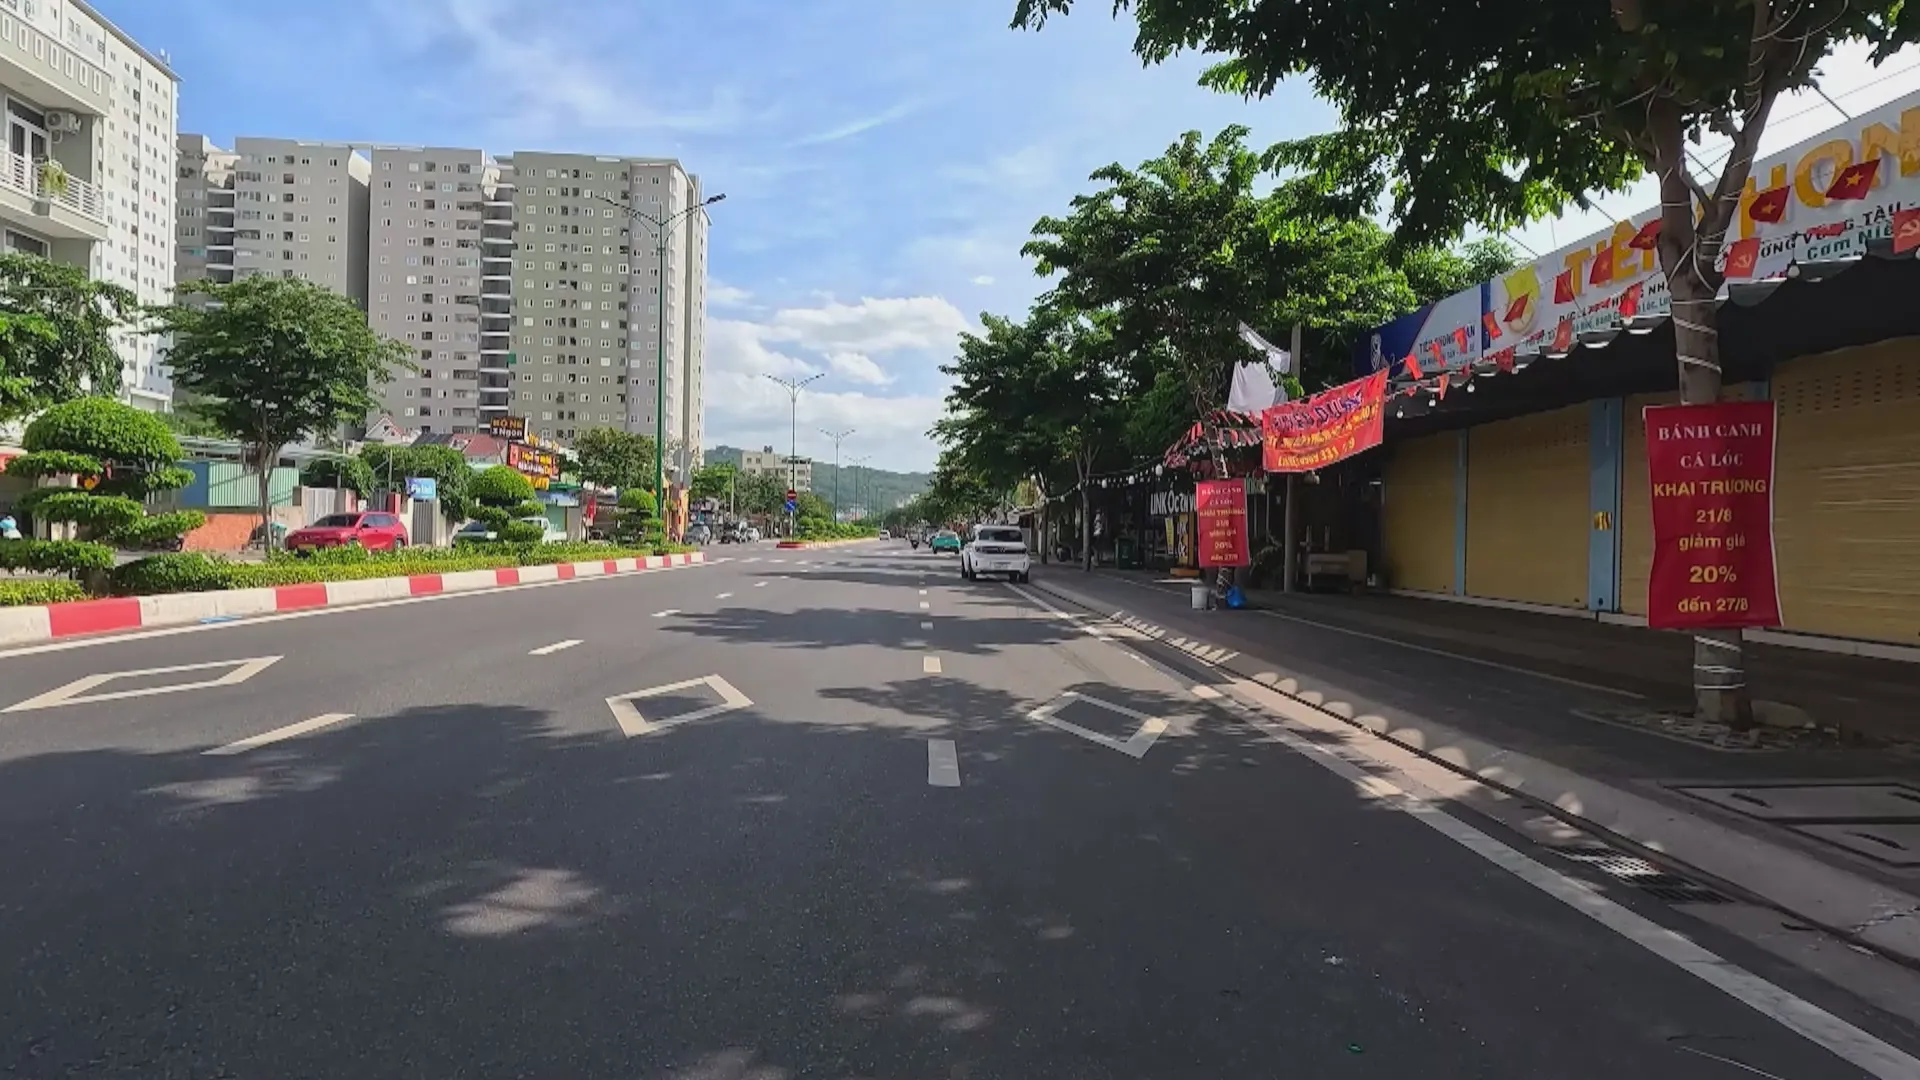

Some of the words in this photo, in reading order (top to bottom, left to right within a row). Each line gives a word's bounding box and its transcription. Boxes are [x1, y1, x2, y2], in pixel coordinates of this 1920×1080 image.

[1658, 421, 1710, 441] BÁNH
[1715, 423, 1762, 437] CANH
[1680, 451, 1705, 468] CÁ
[1711, 449, 1744, 466] LÓC
[1653, 481, 1696, 497] KHAI
[1700, 479, 1767, 495] TRƯƠNG
[1696, 509, 1732, 523] 21/8
[1679, 534, 1721, 551] giảm
[1726, 534, 1746, 551] giá
[1689, 565, 1737, 583] 20%
[1678, 595, 1711, 612] đến
[1716, 597, 1748, 612] 27/8
